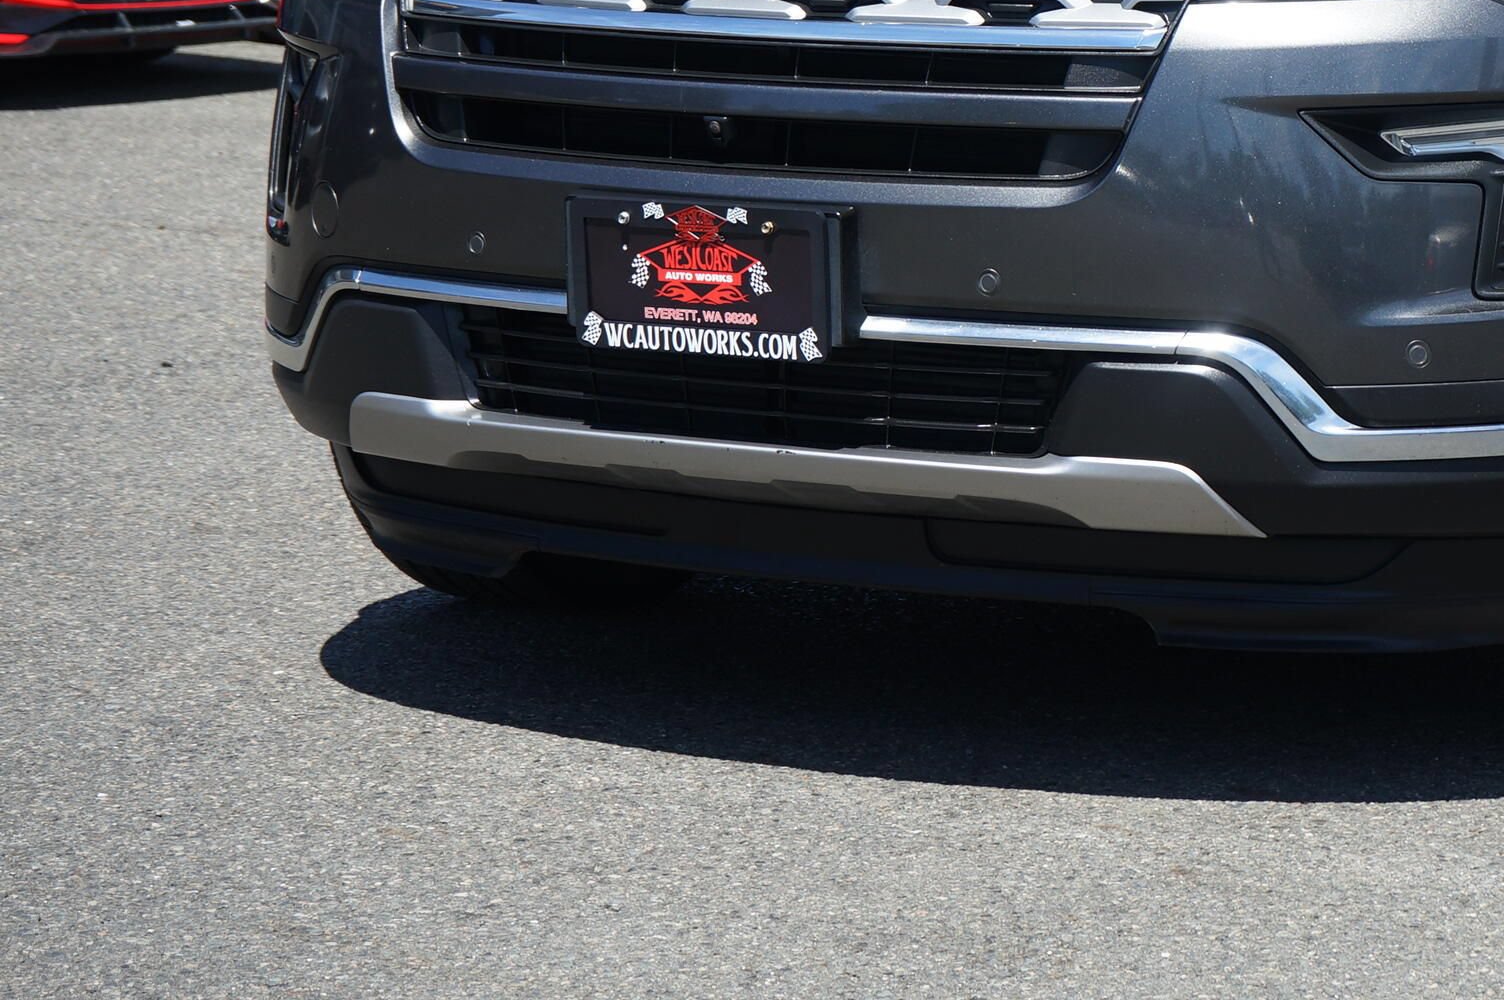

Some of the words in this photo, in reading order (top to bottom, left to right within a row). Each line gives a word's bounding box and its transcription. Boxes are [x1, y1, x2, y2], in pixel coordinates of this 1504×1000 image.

[665, 271, 693, 281] AUTO
[695, 272, 733, 283] WORKS
[644, 306, 701, 324] EVERETT,
[702, 310, 723, 323] WA
[603, 322, 797, 360] WCAUTOWORKS.COM
